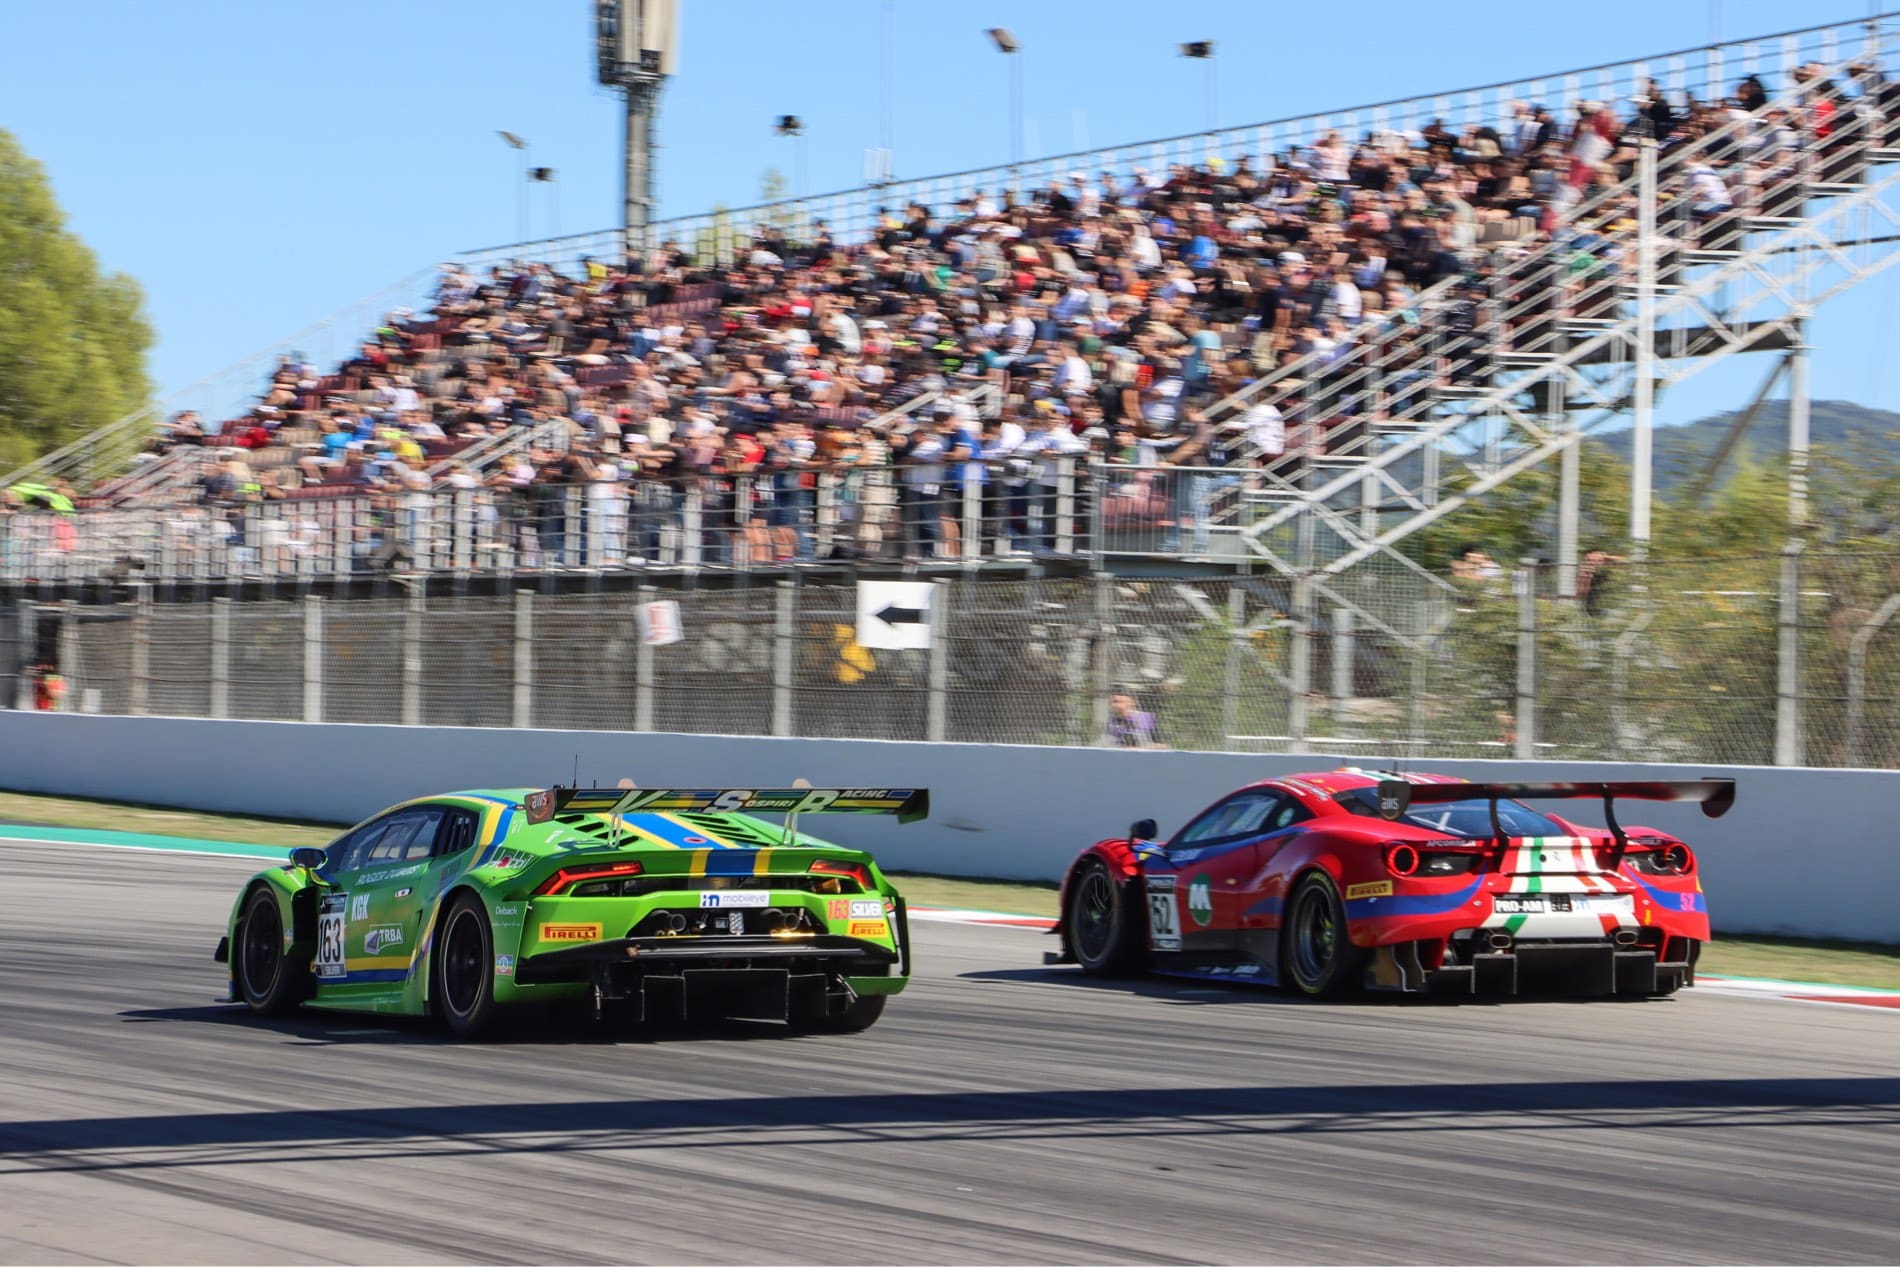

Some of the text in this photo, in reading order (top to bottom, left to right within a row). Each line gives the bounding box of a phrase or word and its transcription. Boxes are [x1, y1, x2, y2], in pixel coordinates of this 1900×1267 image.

[1351, 882, 1388, 896] PIRELLI
[351, 893, 370, 922] KGK
[827, 899, 850, 920] 163
[1495, 900, 1544, 913] PRO-AM
[1680, 893, 1696, 911] 52
[1151, 894, 1174, 935] 52
[379, 928, 402, 943] TRBA
[544, 926, 597, 940] PIRELLI
[851, 922, 886, 936] PIRELLI
[319, 918, 342, 964] 163
